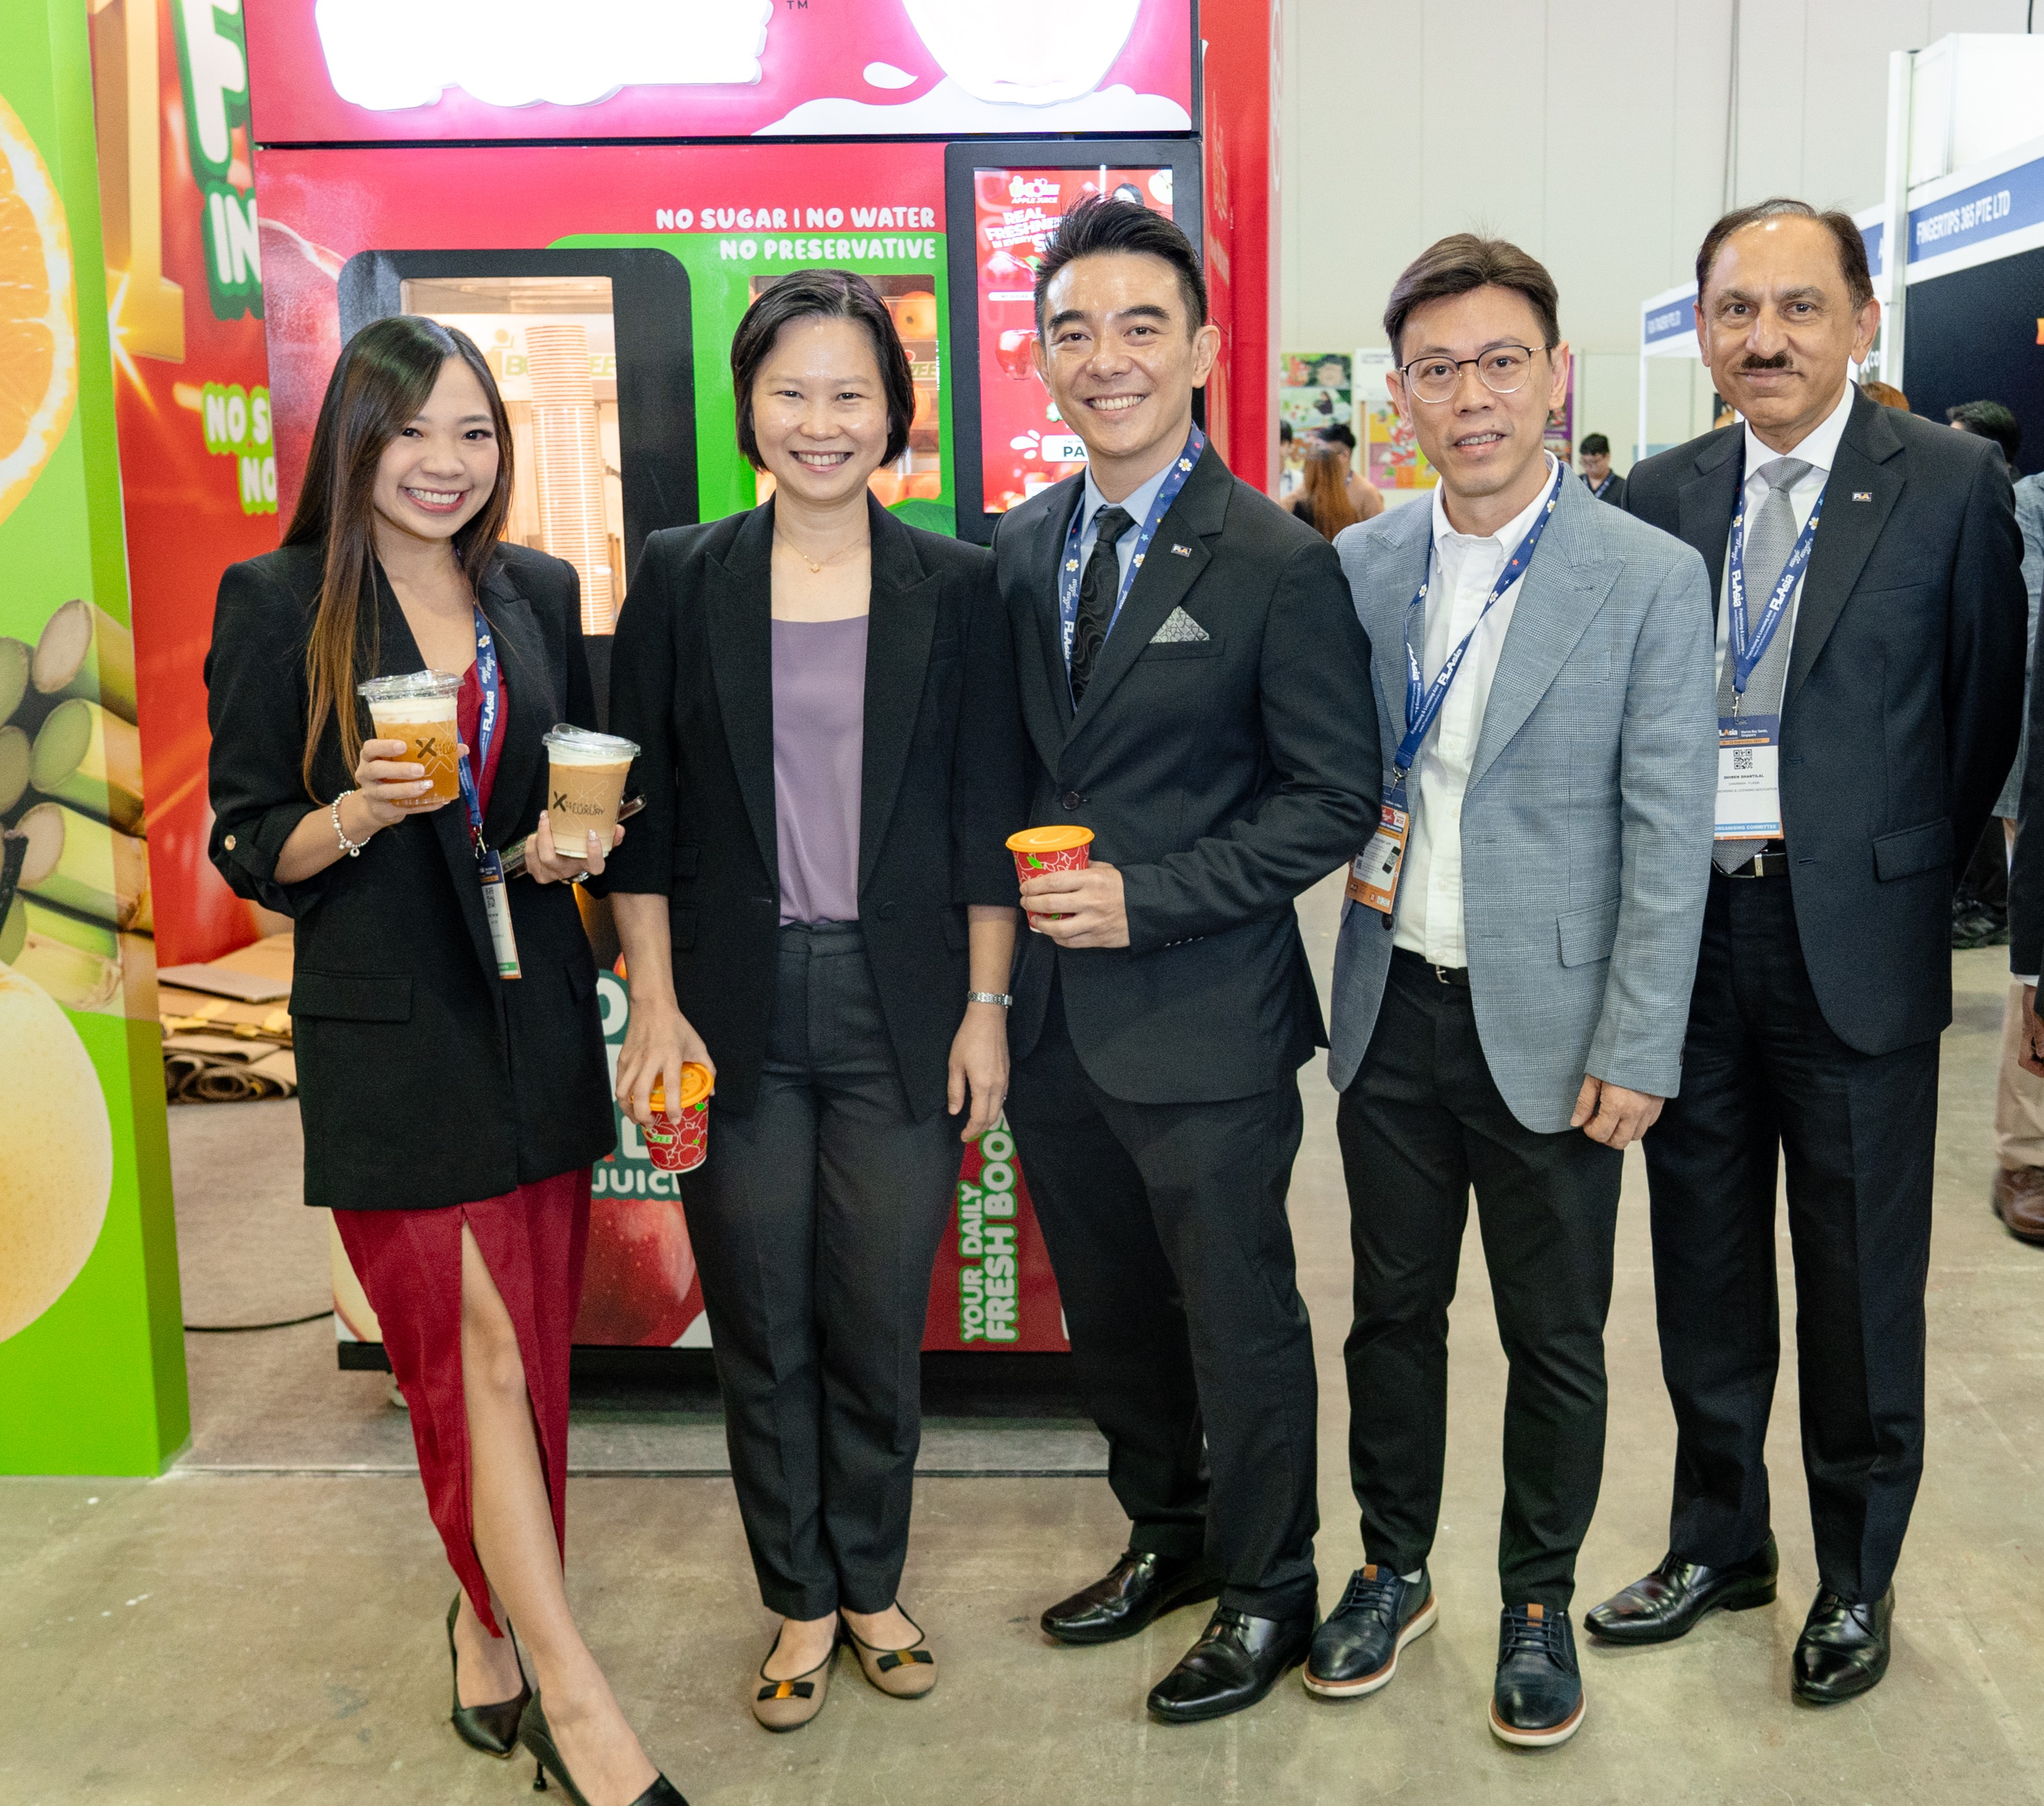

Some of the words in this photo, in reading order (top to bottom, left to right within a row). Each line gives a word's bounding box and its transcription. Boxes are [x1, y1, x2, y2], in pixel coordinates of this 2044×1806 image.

[787, 0, 808, 9] TM
[656, 208, 693, 229] NO
[701, 208, 788, 229] SUGAR
[806, 207, 844, 229] NO
[851, 207, 935, 229] WATER
[984, 216, 1064, 241] FRESHNE
[1002, 207, 1046, 225] REAL
[1916, 209, 1960, 245] FINGERTIPS
[1975, 196, 1992, 225] PTE
[1992, 190, 2011, 219] LTD
[720, 239, 758, 260] NO
[764, 238, 936, 260] PRESERVATIVE
[207, 394, 247, 445] NO
[1063, 446, 1086, 457] PA
[242, 456, 278, 503] NO
[1731, 569, 1744, 607] FLAsia
[1769, 574, 1795, 611] FLAsia
[1437, 648, 1463, 687] FLAsia
[482, 691, 495, 732] FLAsia
[1410, 713, 1425, 735] Franchising
[1423, 692, 1435, 711] Licensing
[572, 806, 605, 816] LUXURY
[983, 1108, 1014, 1216] BOO
[961, 1183, 983, 1256] DAILY
[985, 1226, 1016, 1339] FRESH
[963, 1268, 983, 1340] YOUR
